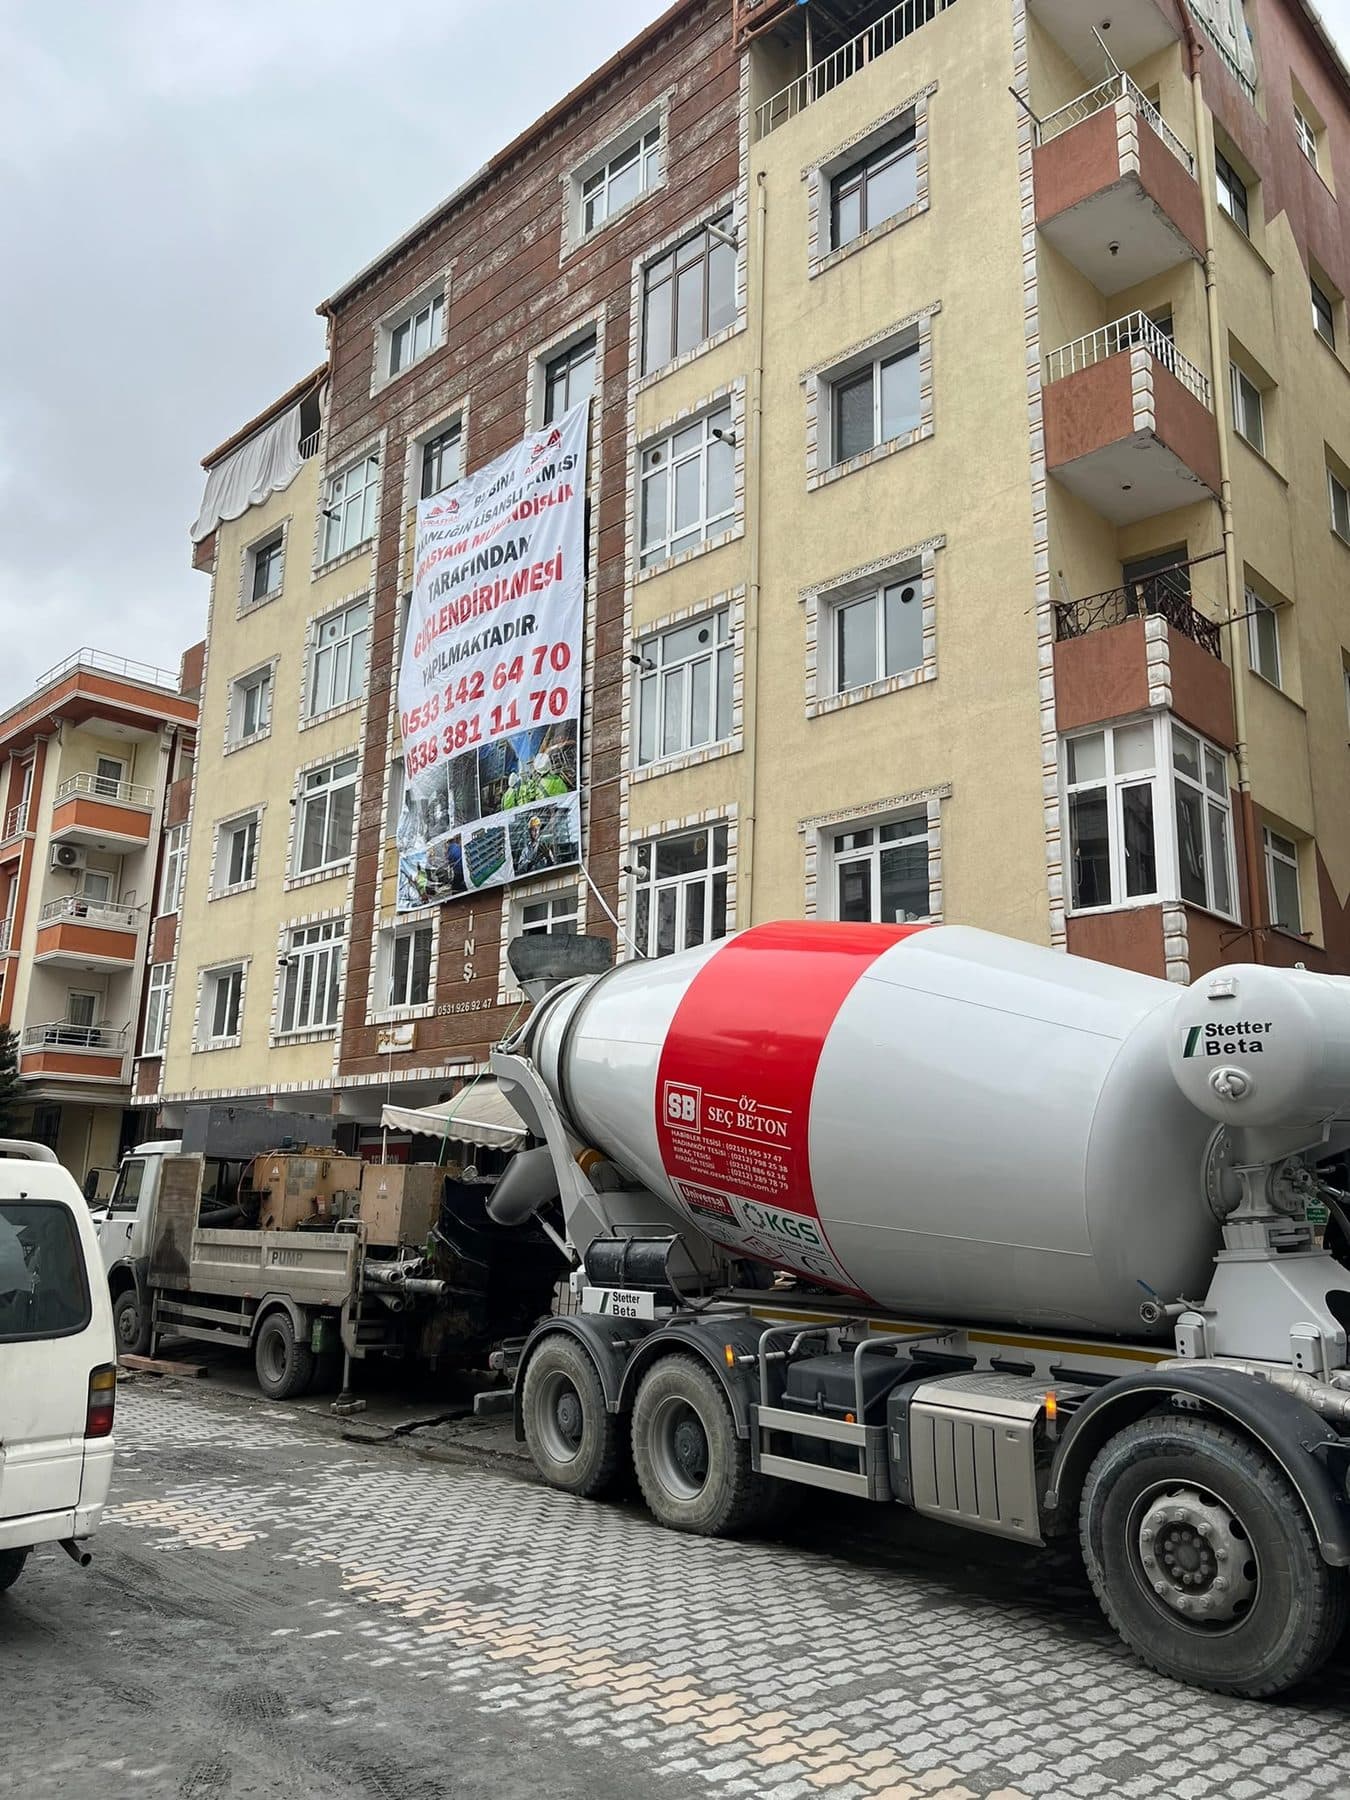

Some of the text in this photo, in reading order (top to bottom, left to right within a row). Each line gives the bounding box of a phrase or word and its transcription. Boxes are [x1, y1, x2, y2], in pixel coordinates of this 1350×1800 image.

[428, 534, 532, 603] TARAFINDAN
[402, 642, 570, 739] 0533 142 64 70
[443, 714, 482, 754] 381
[490, 699, 521, 735] 11
[529, 687, 568, 720] 70
[437, 998, 492, 1015] 0531 926 92 47
[1205, 1021, 1272, 1037] Stetter
[1205, 1039, 1264, 1056] Beta
[668, 1092, 696, 1122] SB
[738, 1095, 757, 1113] ÖZ
[707, 1106, 788, 1137] SEÇ BETON
[725, 1143, 747, 1155] (0212)
[729, 1160, 751, 1172] (0212)
[730, 1152, 753, 1165] (0212)
[730, 1168, 753, 1181] (0212)
[765, 1211, 820, 1245] KGS
[271, 1250, 303, 1265] PUMP
[612, 1291, 640, 1304] Stetter
[612, 1305, 637, 1317] Beta
